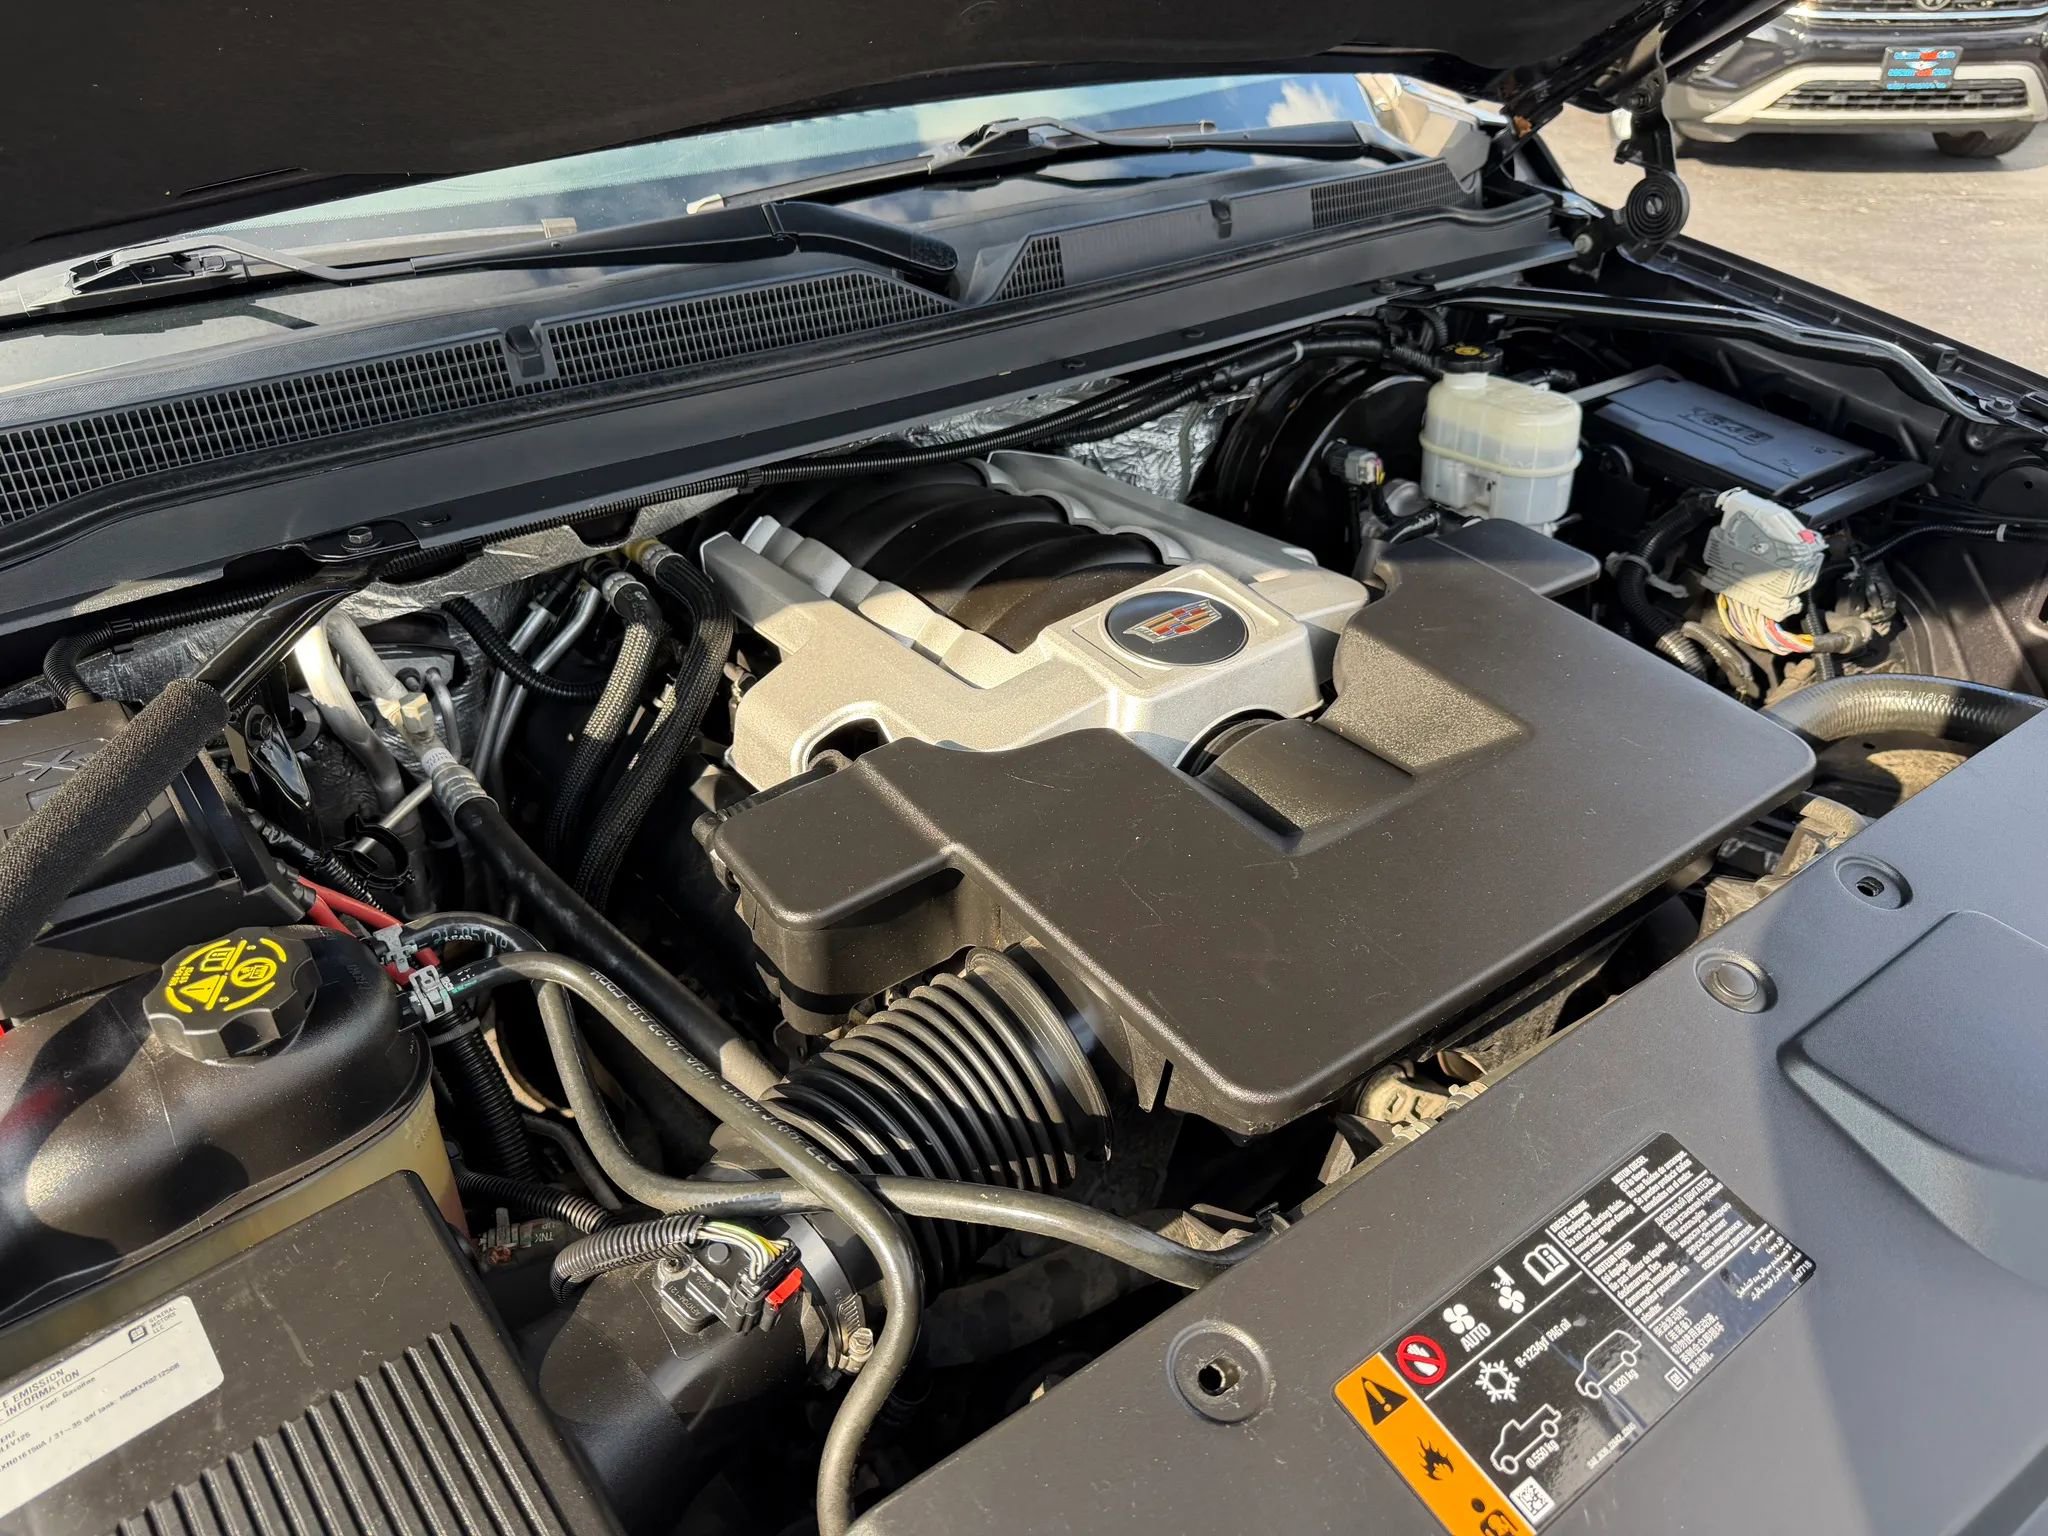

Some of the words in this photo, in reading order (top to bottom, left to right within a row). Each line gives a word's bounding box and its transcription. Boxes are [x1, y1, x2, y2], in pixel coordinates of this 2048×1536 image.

[1611, 1167, 1632, 1185] MOTOR
[1628, 1155, 1648, 1172] DIESEL
[1549, 1215, 1571, 1233] DIESEL
[1567, 1200, 1590, 1219] ENGINE
[1581, 1224, 1594, 1235] use
[1580, 1251, 1592, 1262] can
[1592, 1254, 1618, 1276] MOTEUR
[1613, 1241, 1635, 1259] DIESEL
[1460, 1322, 1492, 1352] AUTO
[1514, 1335, 1550, 1368] R-1234yf
[1546, 1324, 1562, 1342] PAG
[1560, 1318, 1572, 1331] oil
[6, 1369, 80, 1416] INFORMATION
[12, 1368, 64, 1403] EMISSION
[1608, 1372, 1629, 1395] 0.820
[1624, 1368, 1639, 1384] kg
[1526, 1444, 1549, 1468] 0.550
[1544, 1440, 1560, 1454] kg
